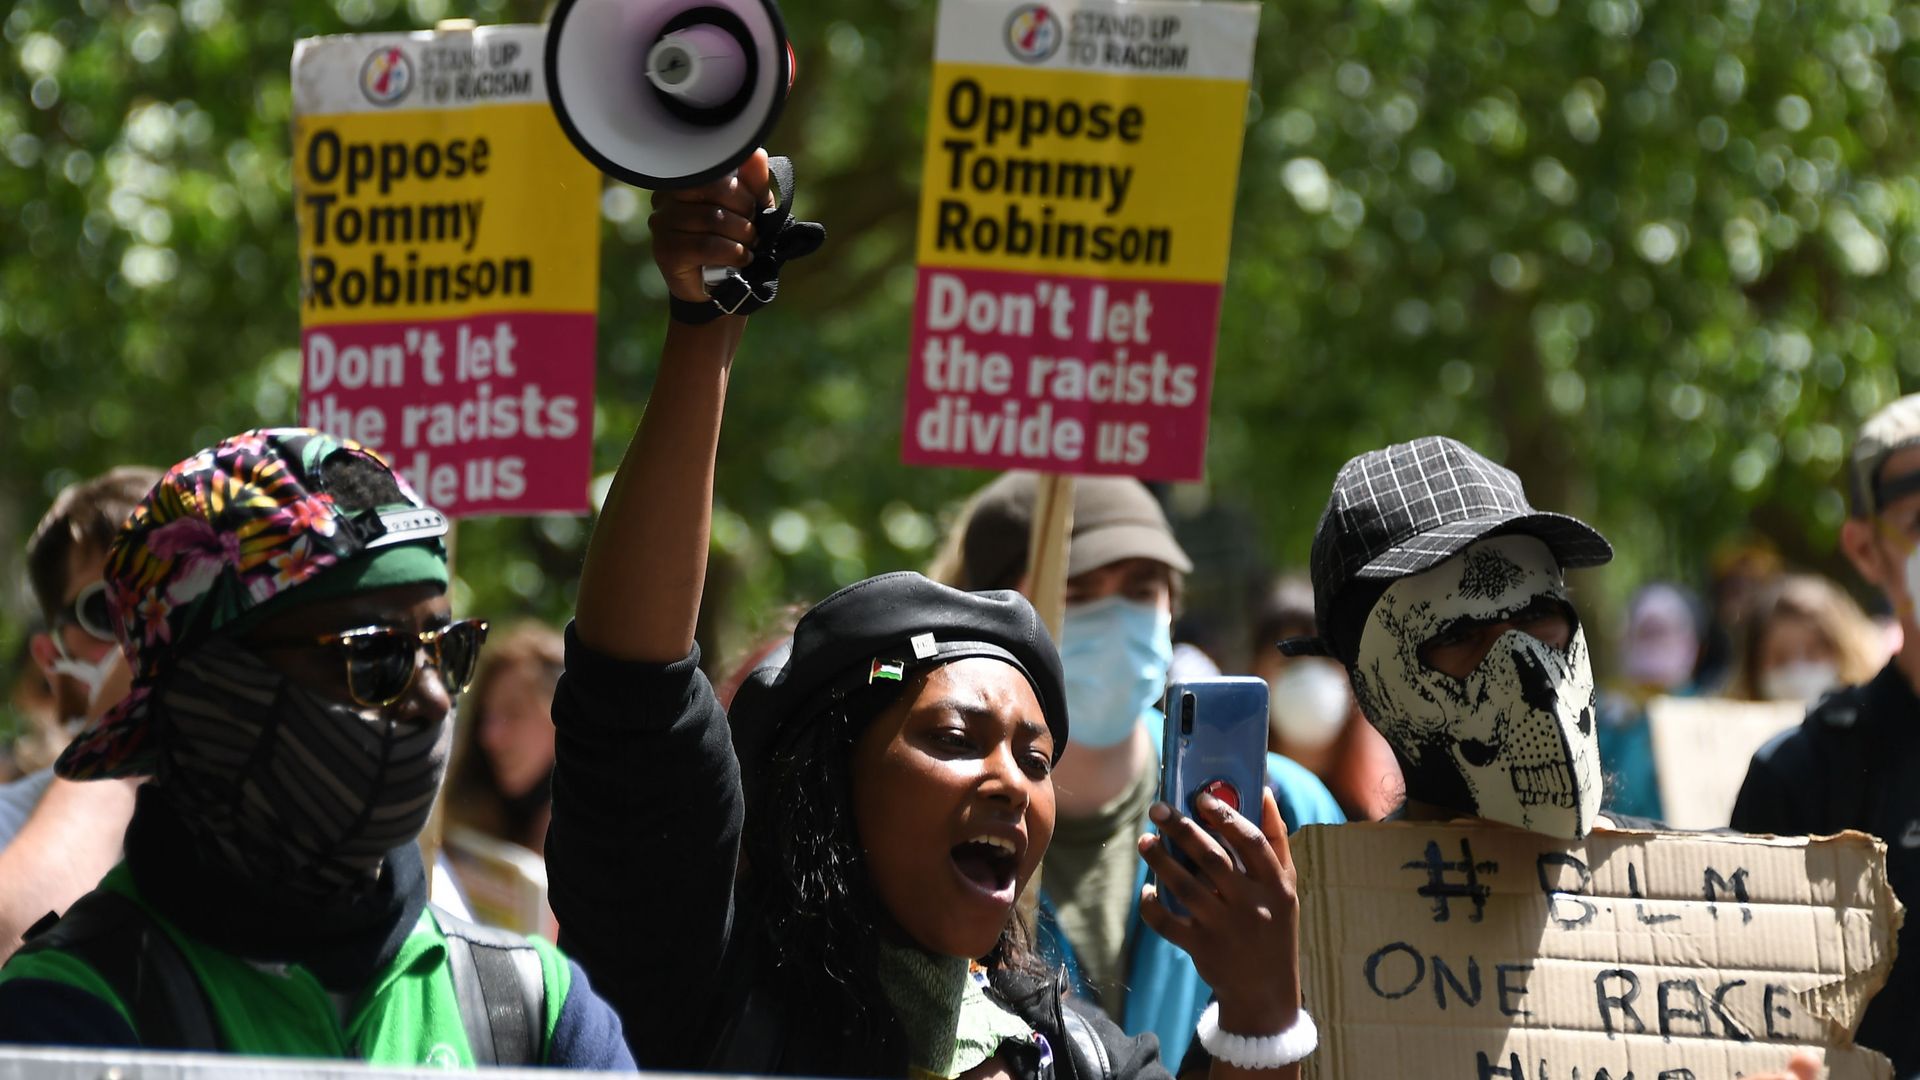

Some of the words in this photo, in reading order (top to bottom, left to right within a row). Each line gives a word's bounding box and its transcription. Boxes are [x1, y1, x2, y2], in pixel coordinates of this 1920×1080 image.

[490, 42, 521, 68] UP
[1068, 40, 1097, 65] TO
[1104, 41, 1188, 70] RACISM
[1149, 15, 1180, 40] UP
[946, 77, 1144, 148] Oppose
[308, 128, 490, 195] Oppose
[942, 139, 1132, 215] Tommy
[305, 194, 484, 250] Tommy
[936, 199, 1172, 265] Robinson
[309, 251, 531, 308] Robinson
[927, 273, 1075, 340] Don't
[1088, 285, 1153, 344] let
[308, 328, 443, 392] Don't
[457, 322, 516, 382] let
[922, 336, 1012, 394] the
[1028, 347, 1197, 406] racists
[308, 393, 385, 447] the
[403, 384, 578, 446] racists
[917, 397, 1084, 460] divide
[1095, 421, 1149, 464] us
[465, 456, 525, 499] us
[1364, 941, 1535, 1016] ONE
